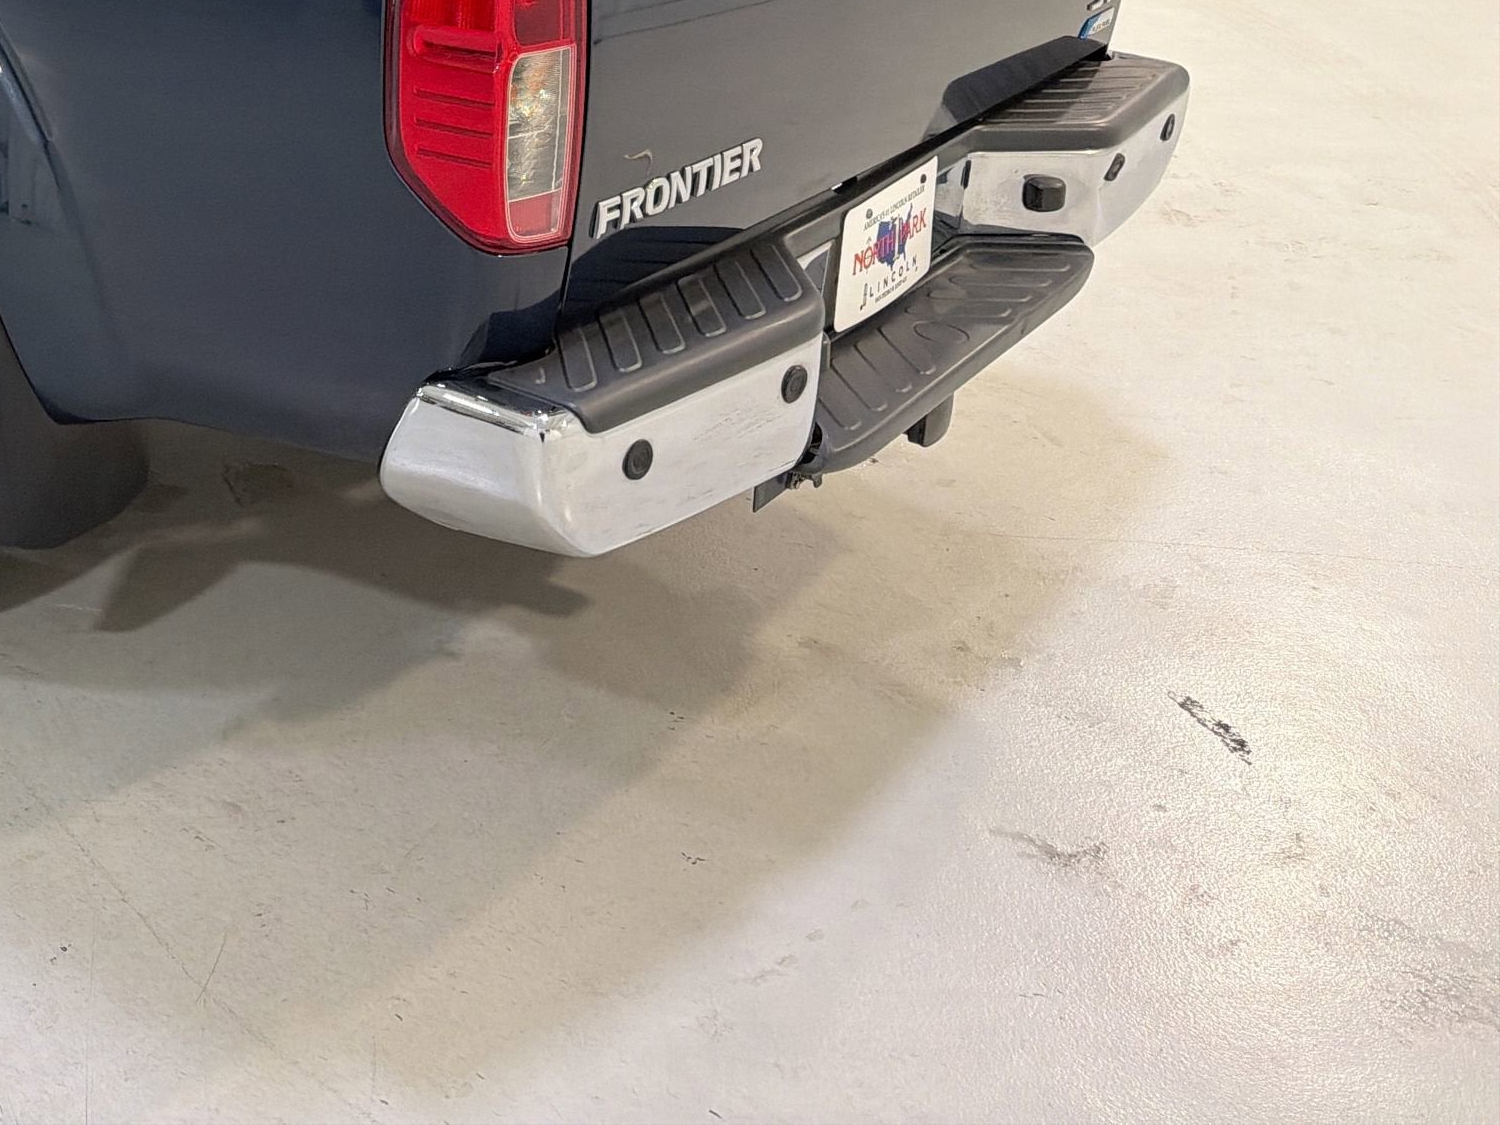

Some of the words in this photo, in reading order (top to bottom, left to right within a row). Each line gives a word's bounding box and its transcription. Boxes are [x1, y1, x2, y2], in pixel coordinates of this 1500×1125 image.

[589, 137, 764, 239] FRONTIER
[852, 232, 894, 276] NORTH
[900, 207, 927, 243] PARK
[869, 254, 917, 298] LINCOLN
